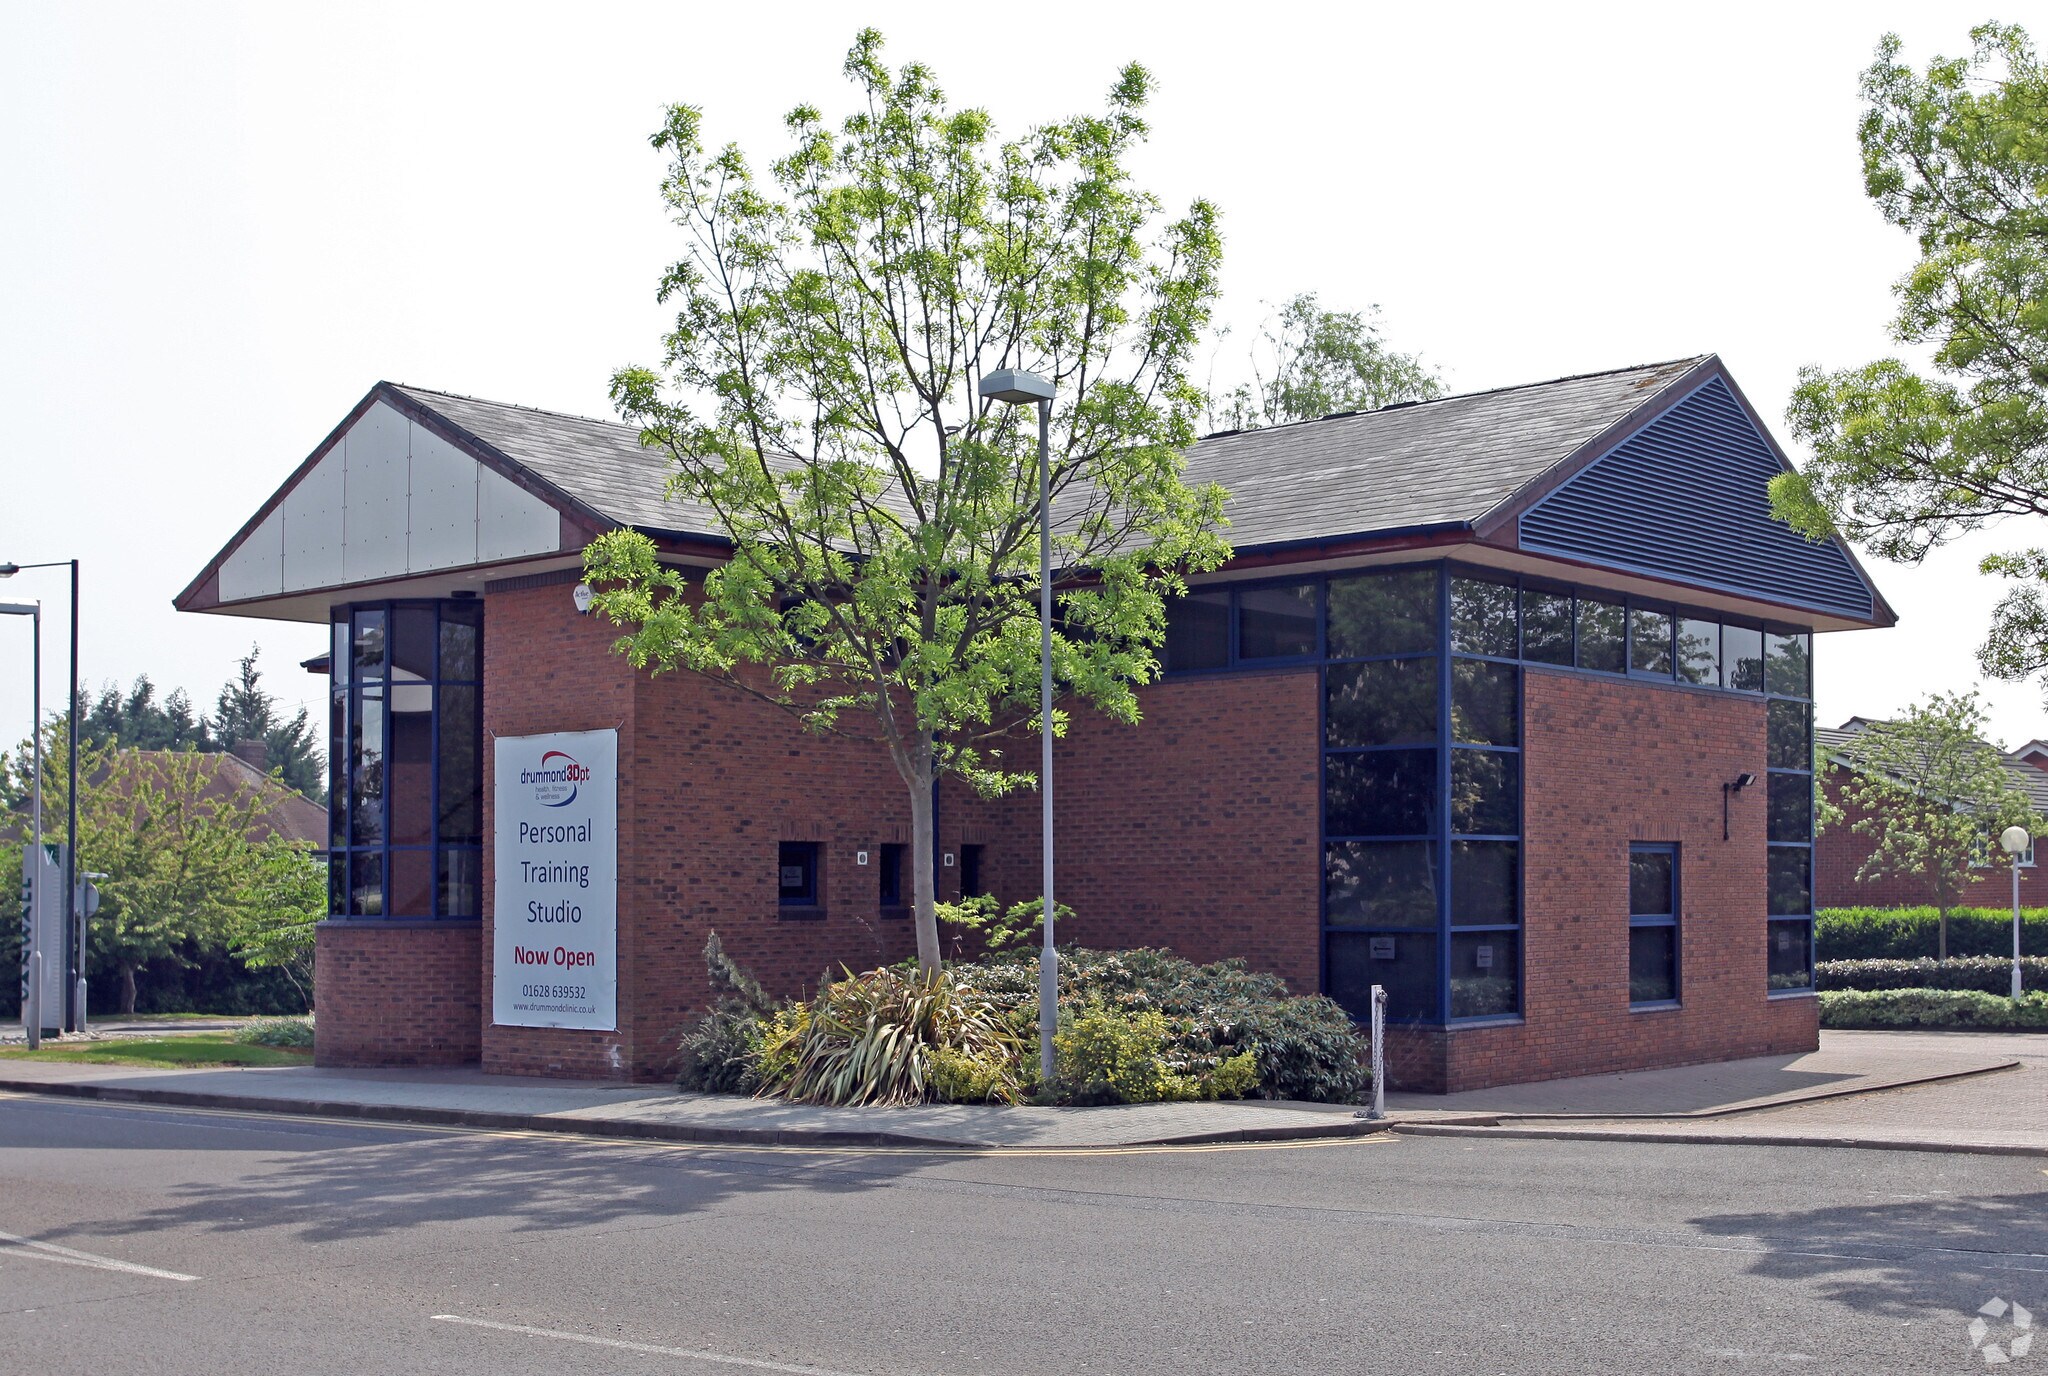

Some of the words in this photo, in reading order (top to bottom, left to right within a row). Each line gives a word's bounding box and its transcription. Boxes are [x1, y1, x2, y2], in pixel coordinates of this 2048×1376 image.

[519, 818, 591, 844] Personal
[520, 860, 590, 889] Training
[527, 899, 582, 923] Studio
[514, 946, 549, 965] Now
[553, 946, 595, 971] Open
[522, 984, 550, 998] 01628
[552, 985, 586, 999] 639532
[512, 1002, 596, 1014] www.drummondclinic.co.uk
